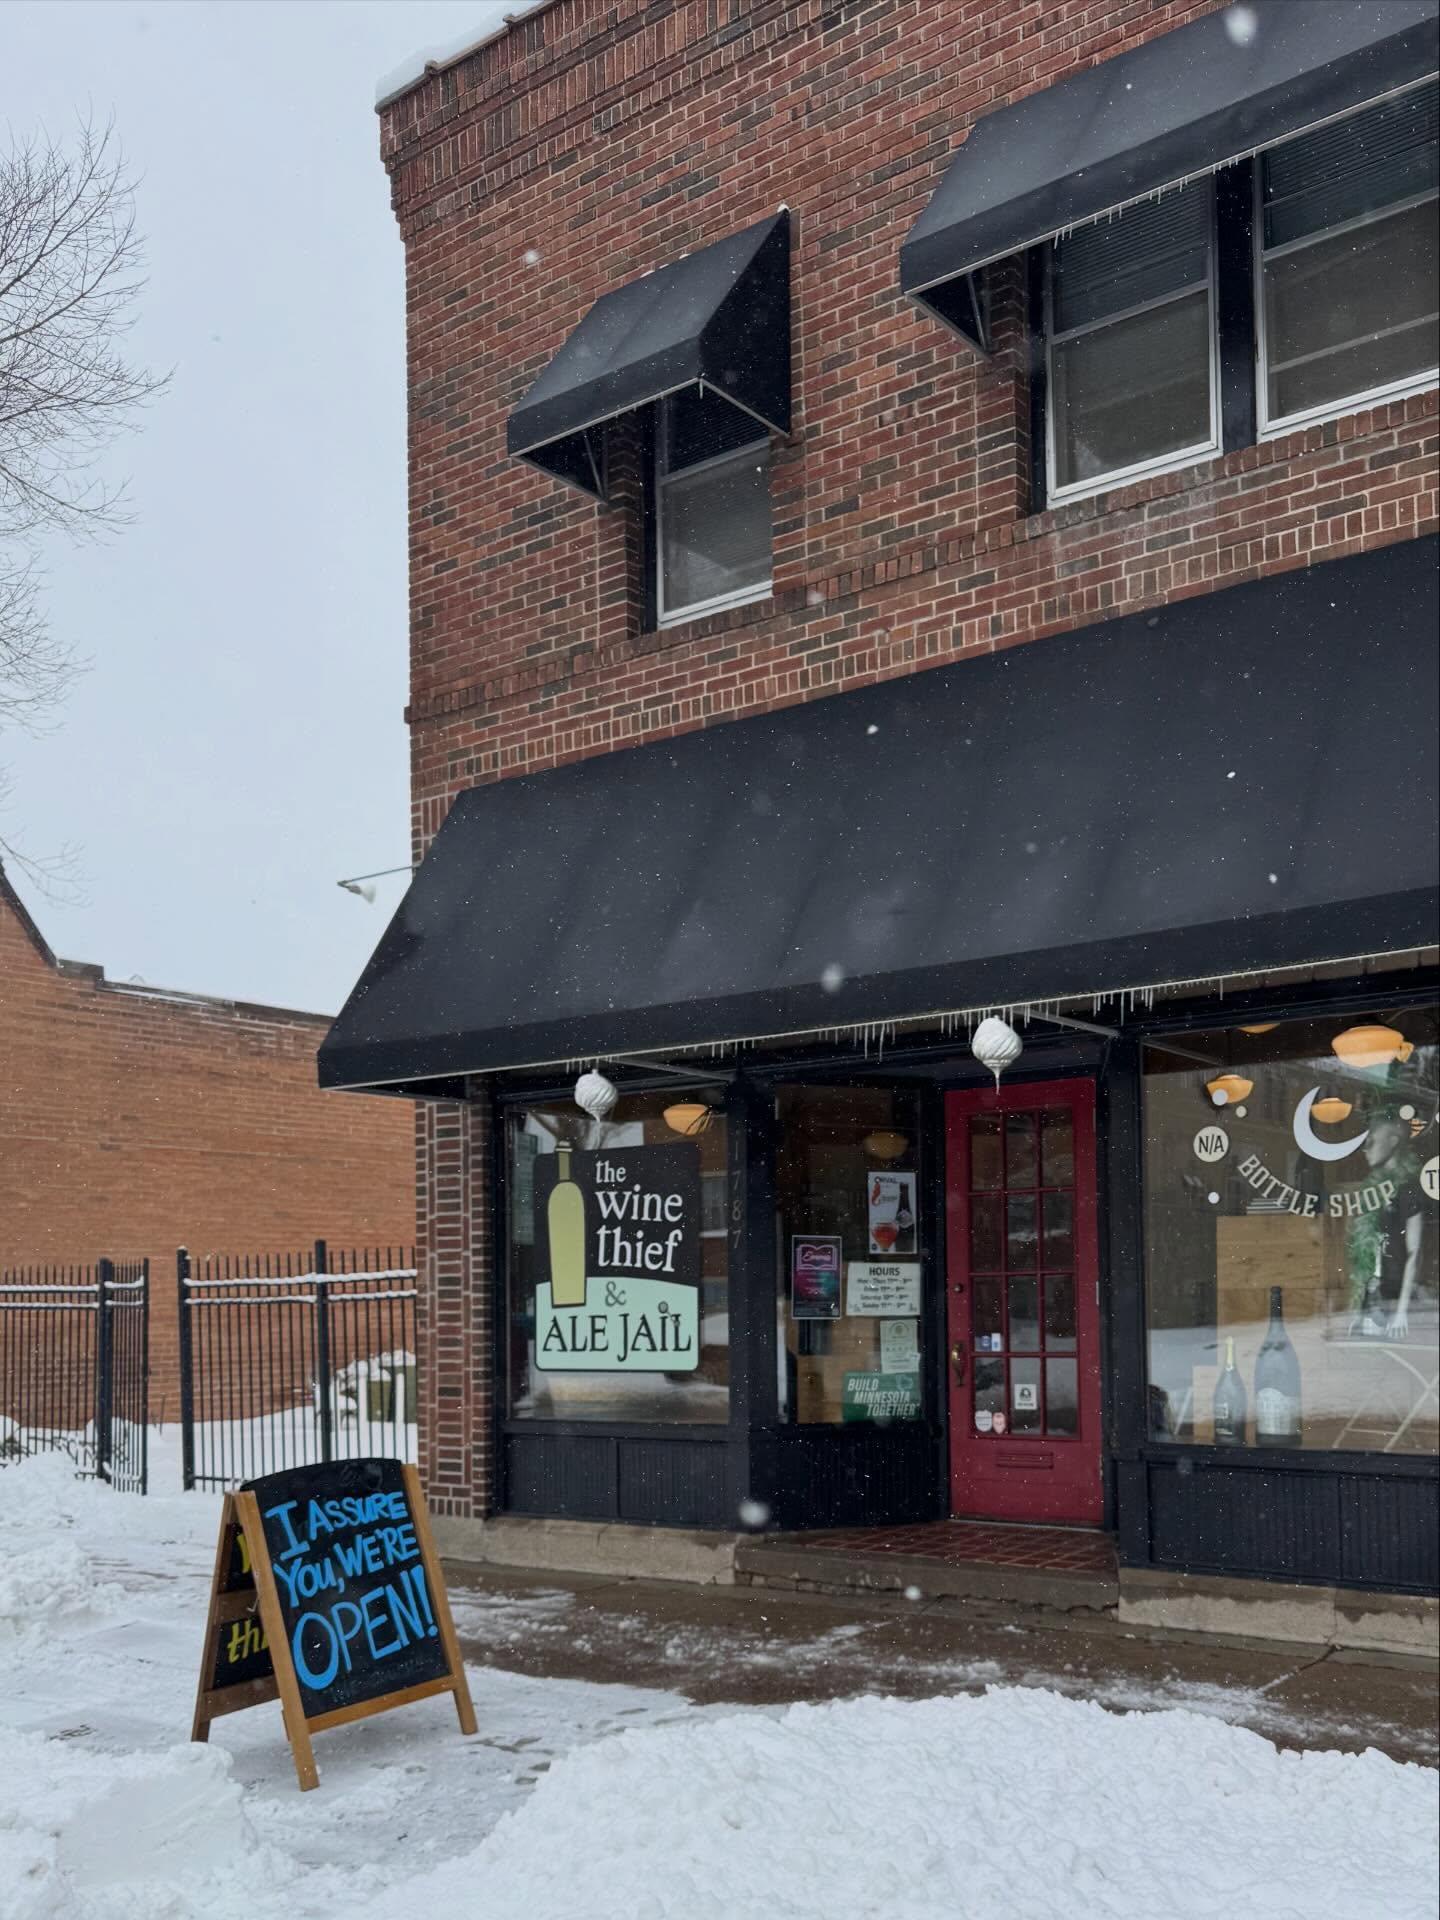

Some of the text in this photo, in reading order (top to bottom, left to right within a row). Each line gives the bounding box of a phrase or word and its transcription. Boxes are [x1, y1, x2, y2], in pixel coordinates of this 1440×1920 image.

[1199, 1134, 1224, 1155] N/A
[596, 1160, 626, 1183] the
[1237, 1154, 1396, 1218] BOTTLE SHOP
[595, 1184, 683, 1222] wine
[597, 1225, 683, 1272] thief
[869, 1267, 900, 1276] HOURS
[604, 1281, 627, 1307] &
[543, 1302, 692, 1362] ALE JAIL
[848, 1378, 879, 1392] BUILD
[854, 1391, 910, 1404] MINNESOTA
[265, 1500, 310, 1561] I
[309, 1491, 408, 1541] ASSURE
[333, 1523, 420, 1577] WE'RE
[293, 1564, 438, 1690] OPEN!
